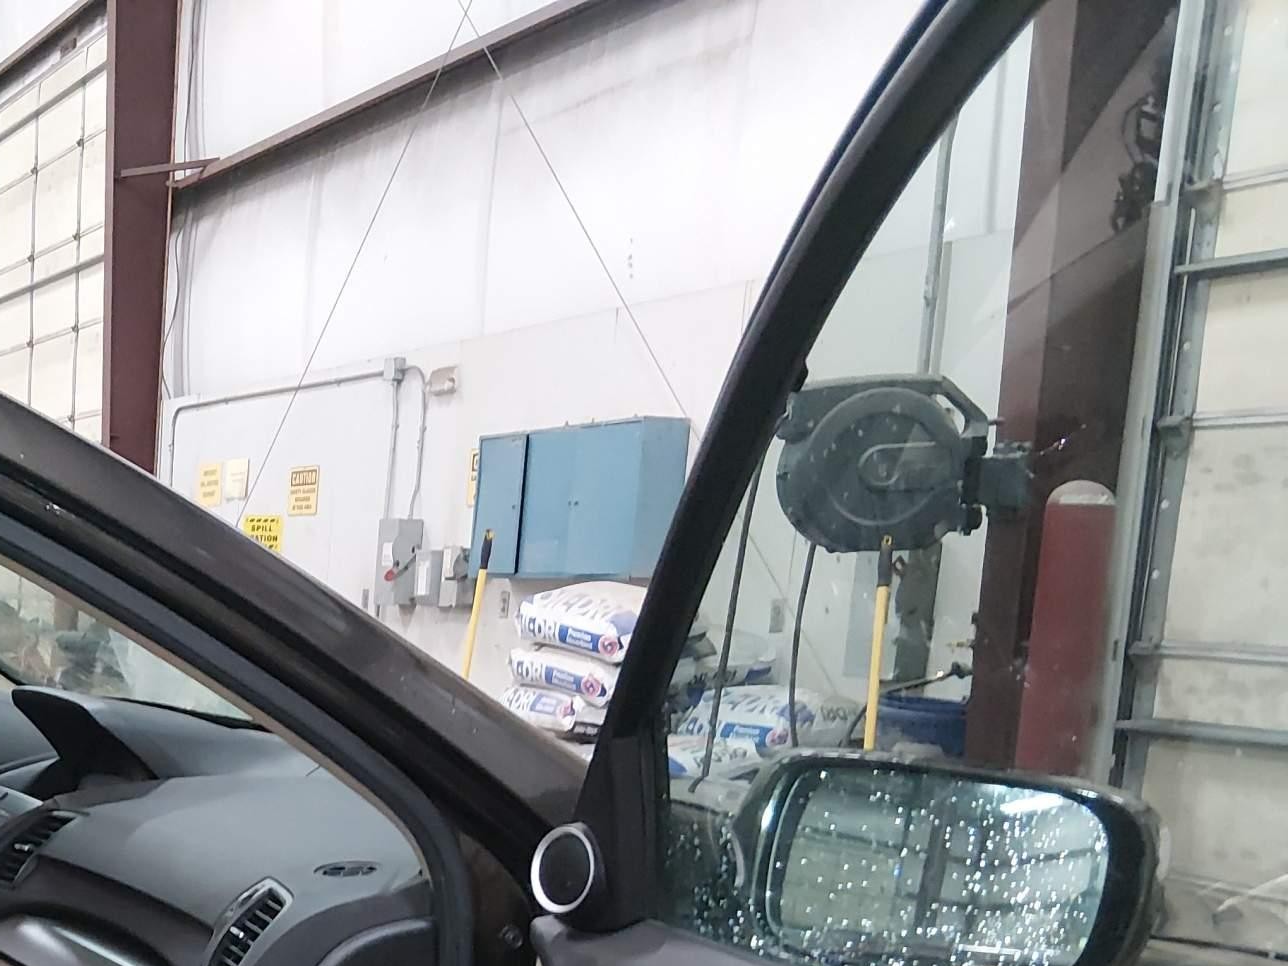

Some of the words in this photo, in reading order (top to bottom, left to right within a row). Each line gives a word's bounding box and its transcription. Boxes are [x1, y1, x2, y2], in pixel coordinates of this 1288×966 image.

[292, 471, 316, 486] CAUTION
[251, 524, 272, 532] SPILL
[251, 534, 278, 543] ATION
